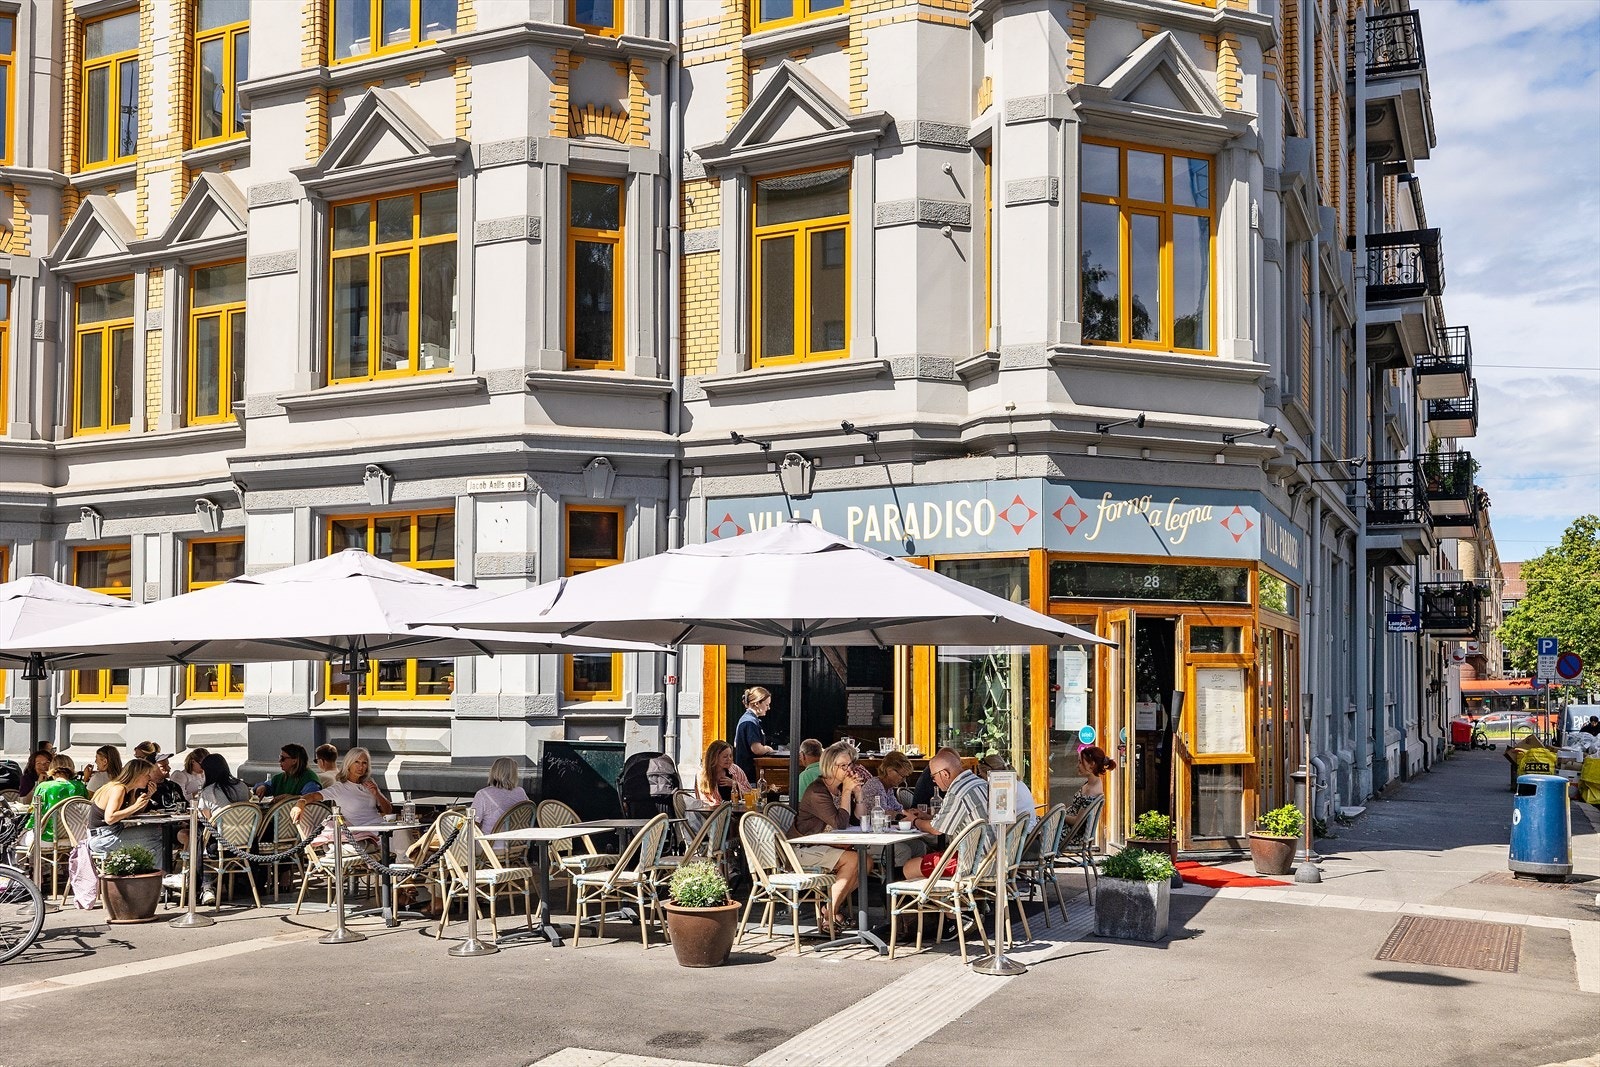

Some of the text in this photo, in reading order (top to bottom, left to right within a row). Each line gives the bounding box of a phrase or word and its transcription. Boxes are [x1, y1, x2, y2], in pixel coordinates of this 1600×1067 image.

[507, 480, 522, 490] gate
[847, 498, 996, 542] PARADISO
[1084, 491, 1152, 540] forno
[1149, 497, 1213, 544] a legna
[1264, 512, 1278, 556] VILLA
[1144, 575, 1160, 588] 28
[1542, 640, 1553, 653] P
